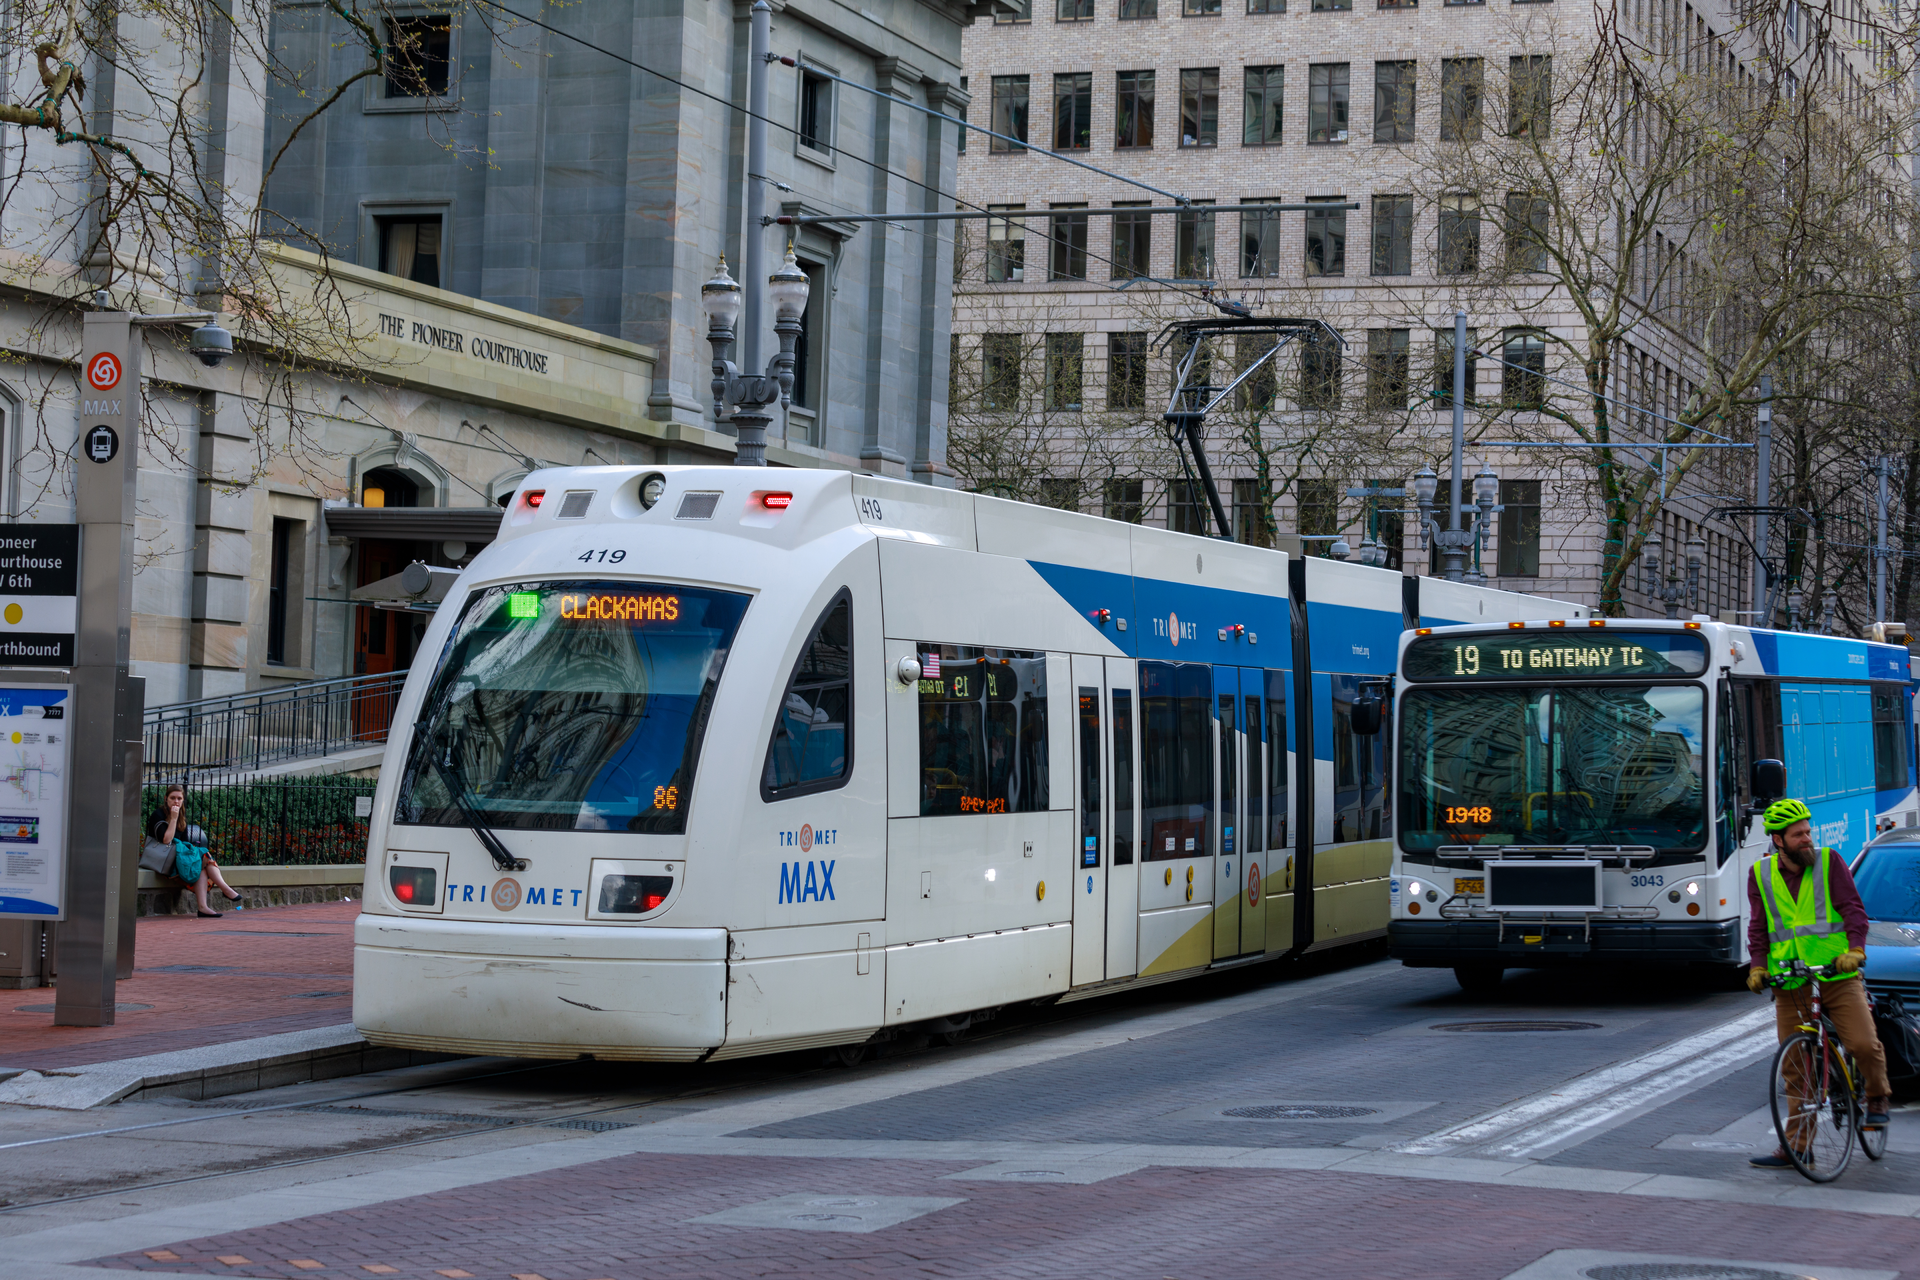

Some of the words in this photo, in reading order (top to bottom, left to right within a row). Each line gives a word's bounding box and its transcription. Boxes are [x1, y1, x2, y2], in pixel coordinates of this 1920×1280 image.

[379, 313, 405, 338] THE
[411, 322, 464, 353] PIONEER
[472, 337, 548, 374] COURTHOUSE
[84, 399, 121, 415] MAX
[862, 497, 882, 521] 419
[577, 549, 627, 564] 419
[8, 573, 32, 588] 6th
[560, 595, 679, 620] CLACKAMAS
[1180, 620, 1197, 640] MET
[1454, 645, 1480, 674] 19
[1500, 649, 1522, 668] TO
[1529, 647, 1613, 668] GATEWAY
[1620, 646, 1644, 666] TC
[653, 785, 679, 809] 86
[1445, 806, 1492, 823] 1948
[779, 830, 798, 846] TRI
[814, 829, 837, 845] MET
[778, 859, 836, 904] MAX
[1630, 875, 1664, 887] 3043
[447, 884, 486, 903] TRI
[526, 886, 583, 907] MET
